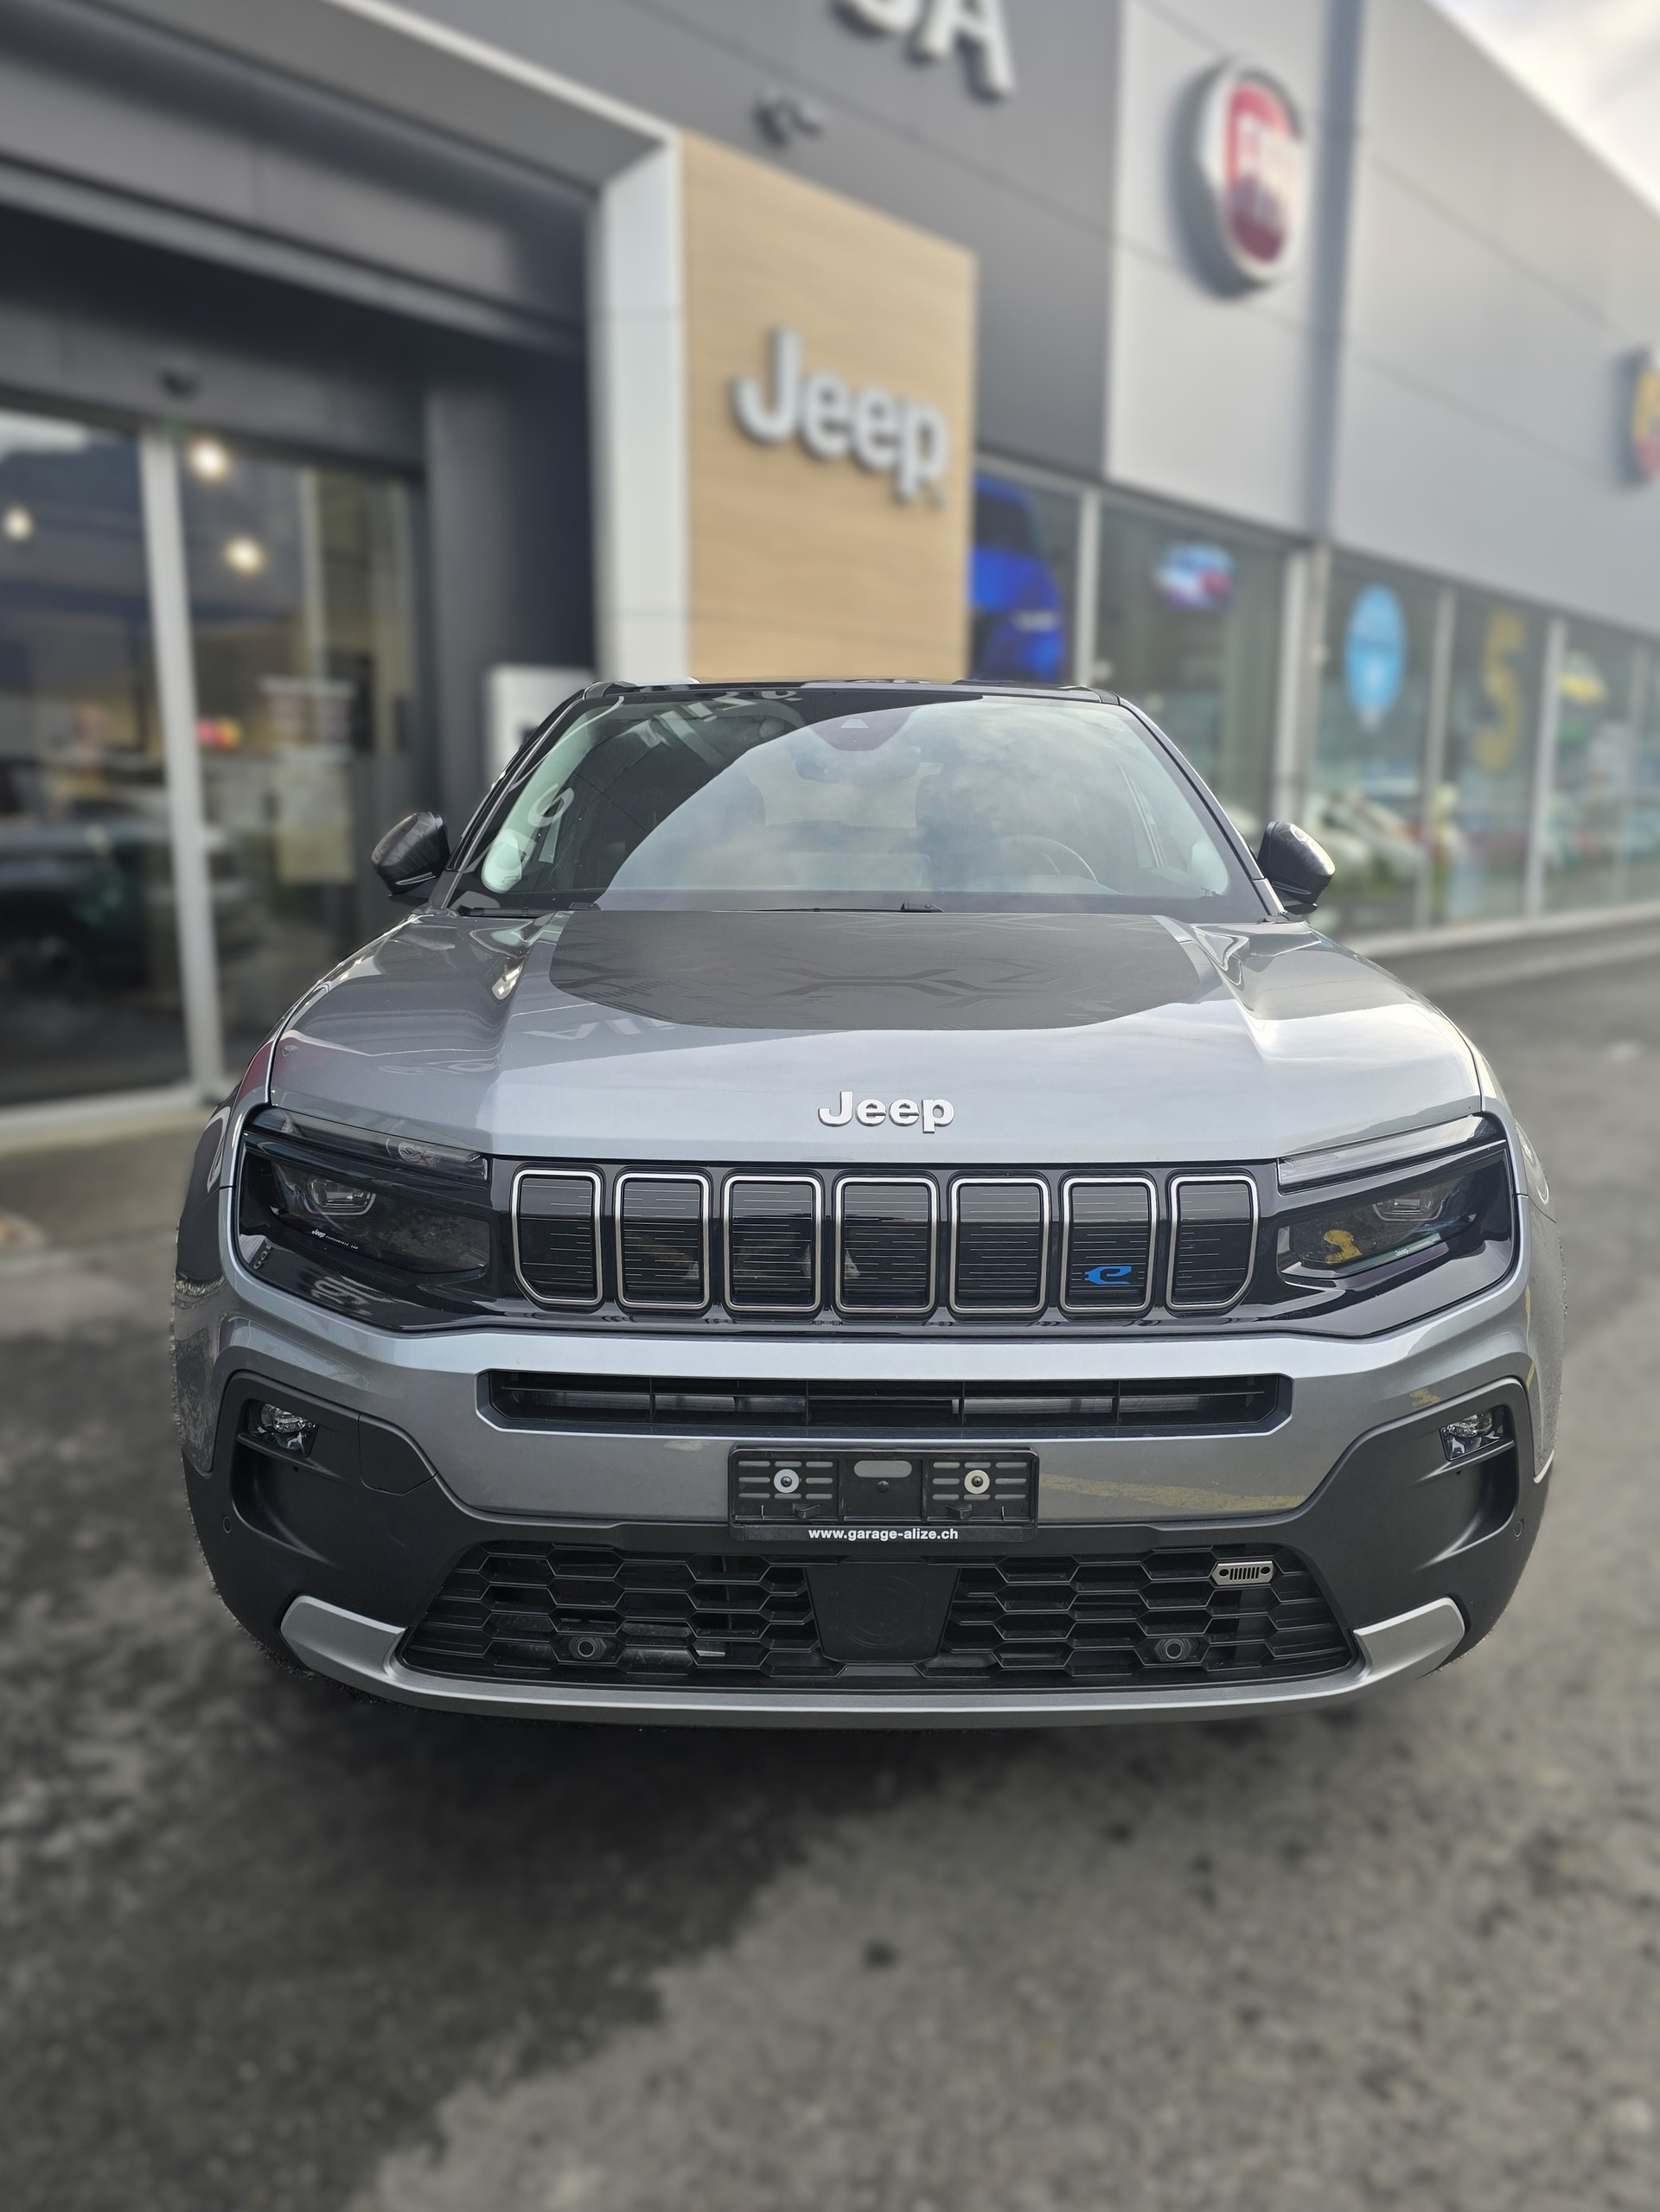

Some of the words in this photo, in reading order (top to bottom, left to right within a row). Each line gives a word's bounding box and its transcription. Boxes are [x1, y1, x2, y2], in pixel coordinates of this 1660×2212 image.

[733, 327, 949, 499] Jeep
[818, 1091, 954, 1134] Jeep
[808, 1527, 959, 1541] www.garage-alize.ch
